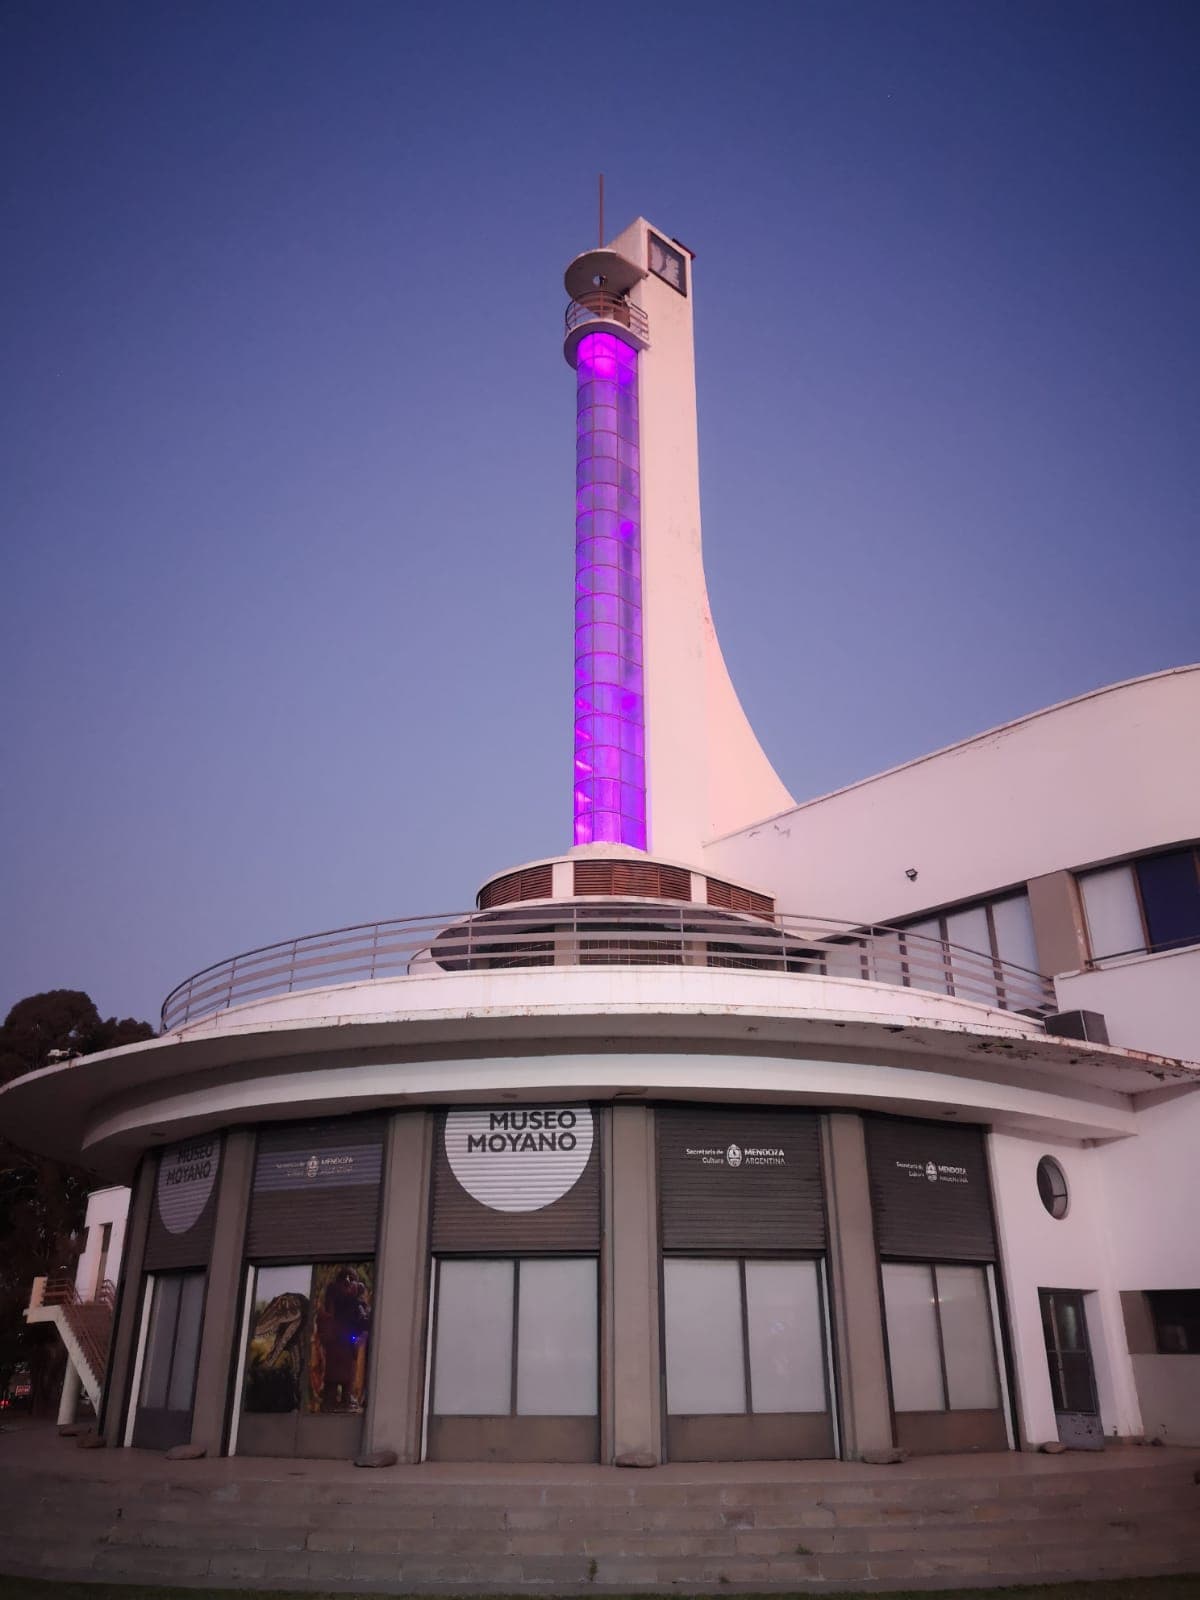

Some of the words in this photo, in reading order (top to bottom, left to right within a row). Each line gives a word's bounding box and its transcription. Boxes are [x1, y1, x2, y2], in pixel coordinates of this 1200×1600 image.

[490, 1111, 577, 1130] MUSEO
[468, 1132, 577, 1153] MOYANO
[744, 1148, 785, 1156] MENDOZA
[745, 1157, 785, 1165] ARGENTINA
[166, 1160, 212, 1186] MOYANO
